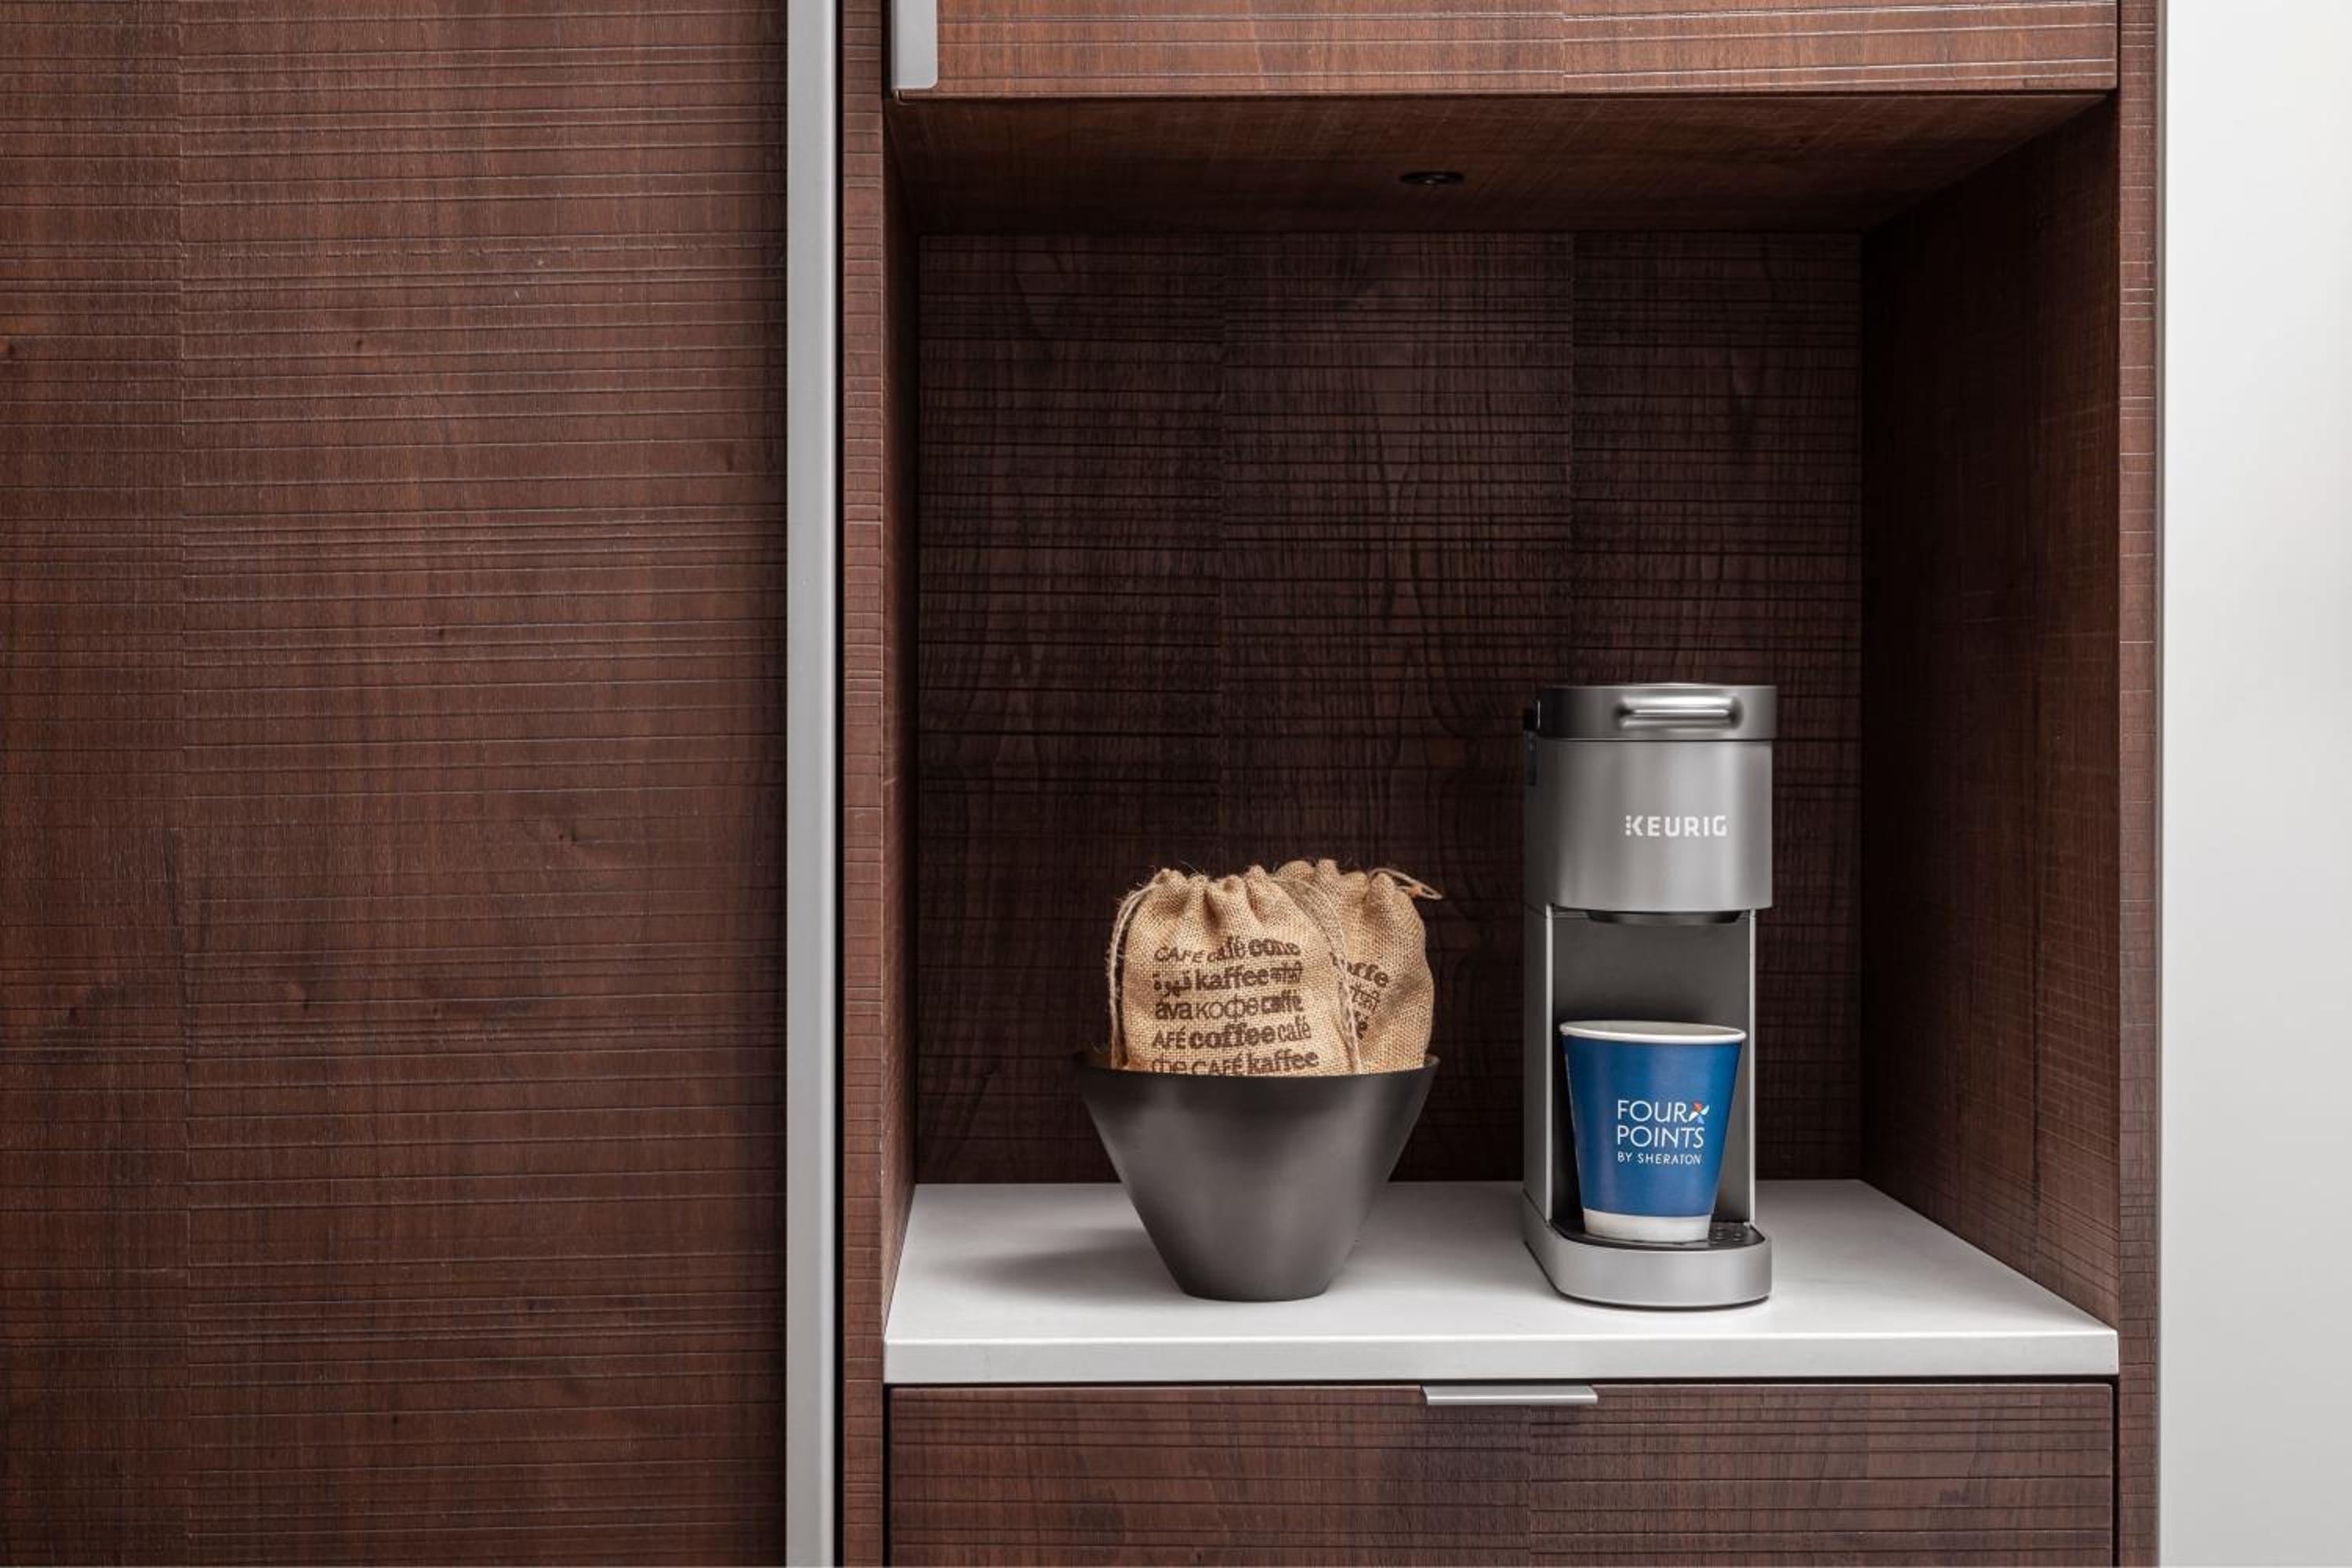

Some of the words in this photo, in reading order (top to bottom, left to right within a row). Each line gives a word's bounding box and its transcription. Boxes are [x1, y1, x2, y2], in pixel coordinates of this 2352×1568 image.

[1625, 815, 1728, 837] KEURIG
[1195, 964, 1269, 990] kaffee
[1189, 1022, 1276, 1049] coffee
[1277, 1016, 1312, 1042] café
[1247, 1049, 1320, 1073] kaffee
[1617, 1099, 1688, 1123] FOUR
[1617, 1125, 1704, 1149] POINTS
[1617, 1152, 1632, 1163] BY
[1637, 1153, 1701, 1164] SHERATON
